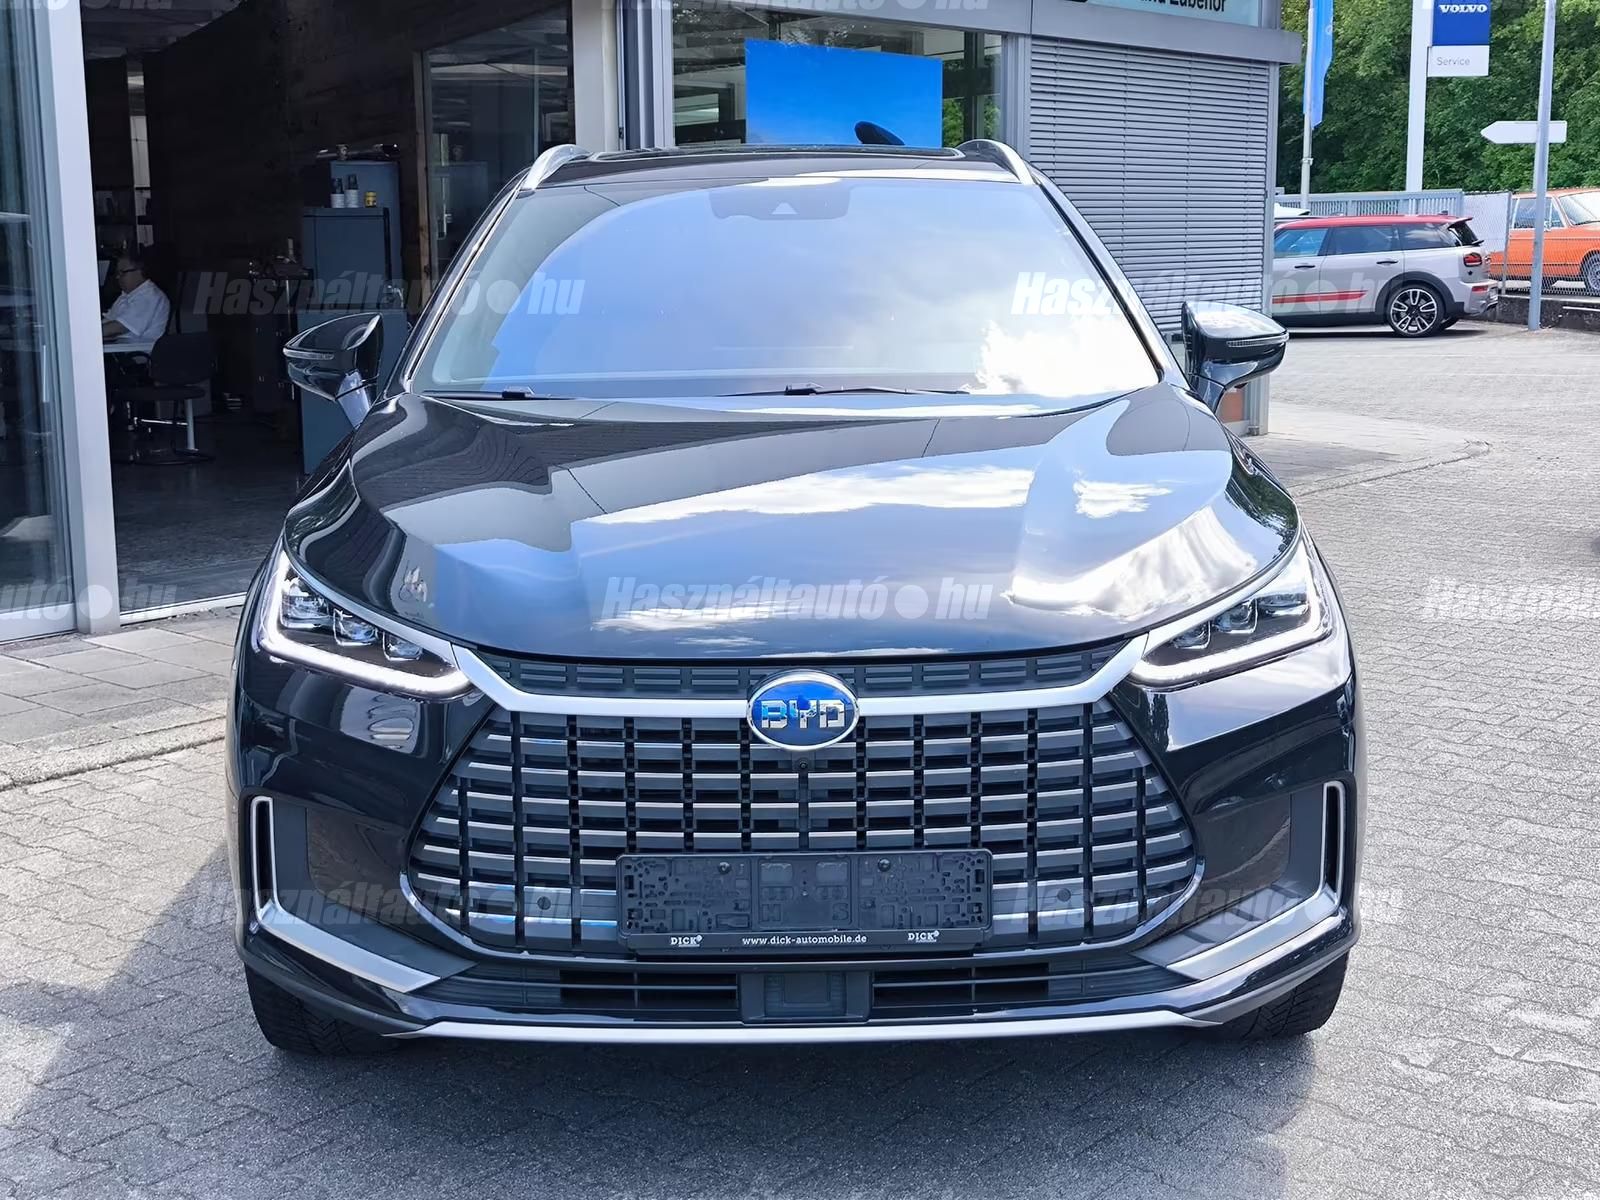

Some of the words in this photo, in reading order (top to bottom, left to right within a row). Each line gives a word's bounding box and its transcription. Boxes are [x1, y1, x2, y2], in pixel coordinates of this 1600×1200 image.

[1439, 4, 1488, 13] VOLVO
[1436, 57, 1470, 66] Service
[761, 699, 845, 729] BYD
[670, 936, 698, 945] DICK
[742, 935, 868, 946] www.dick-automobile.de
[907, 932, 935, 941] DICK
